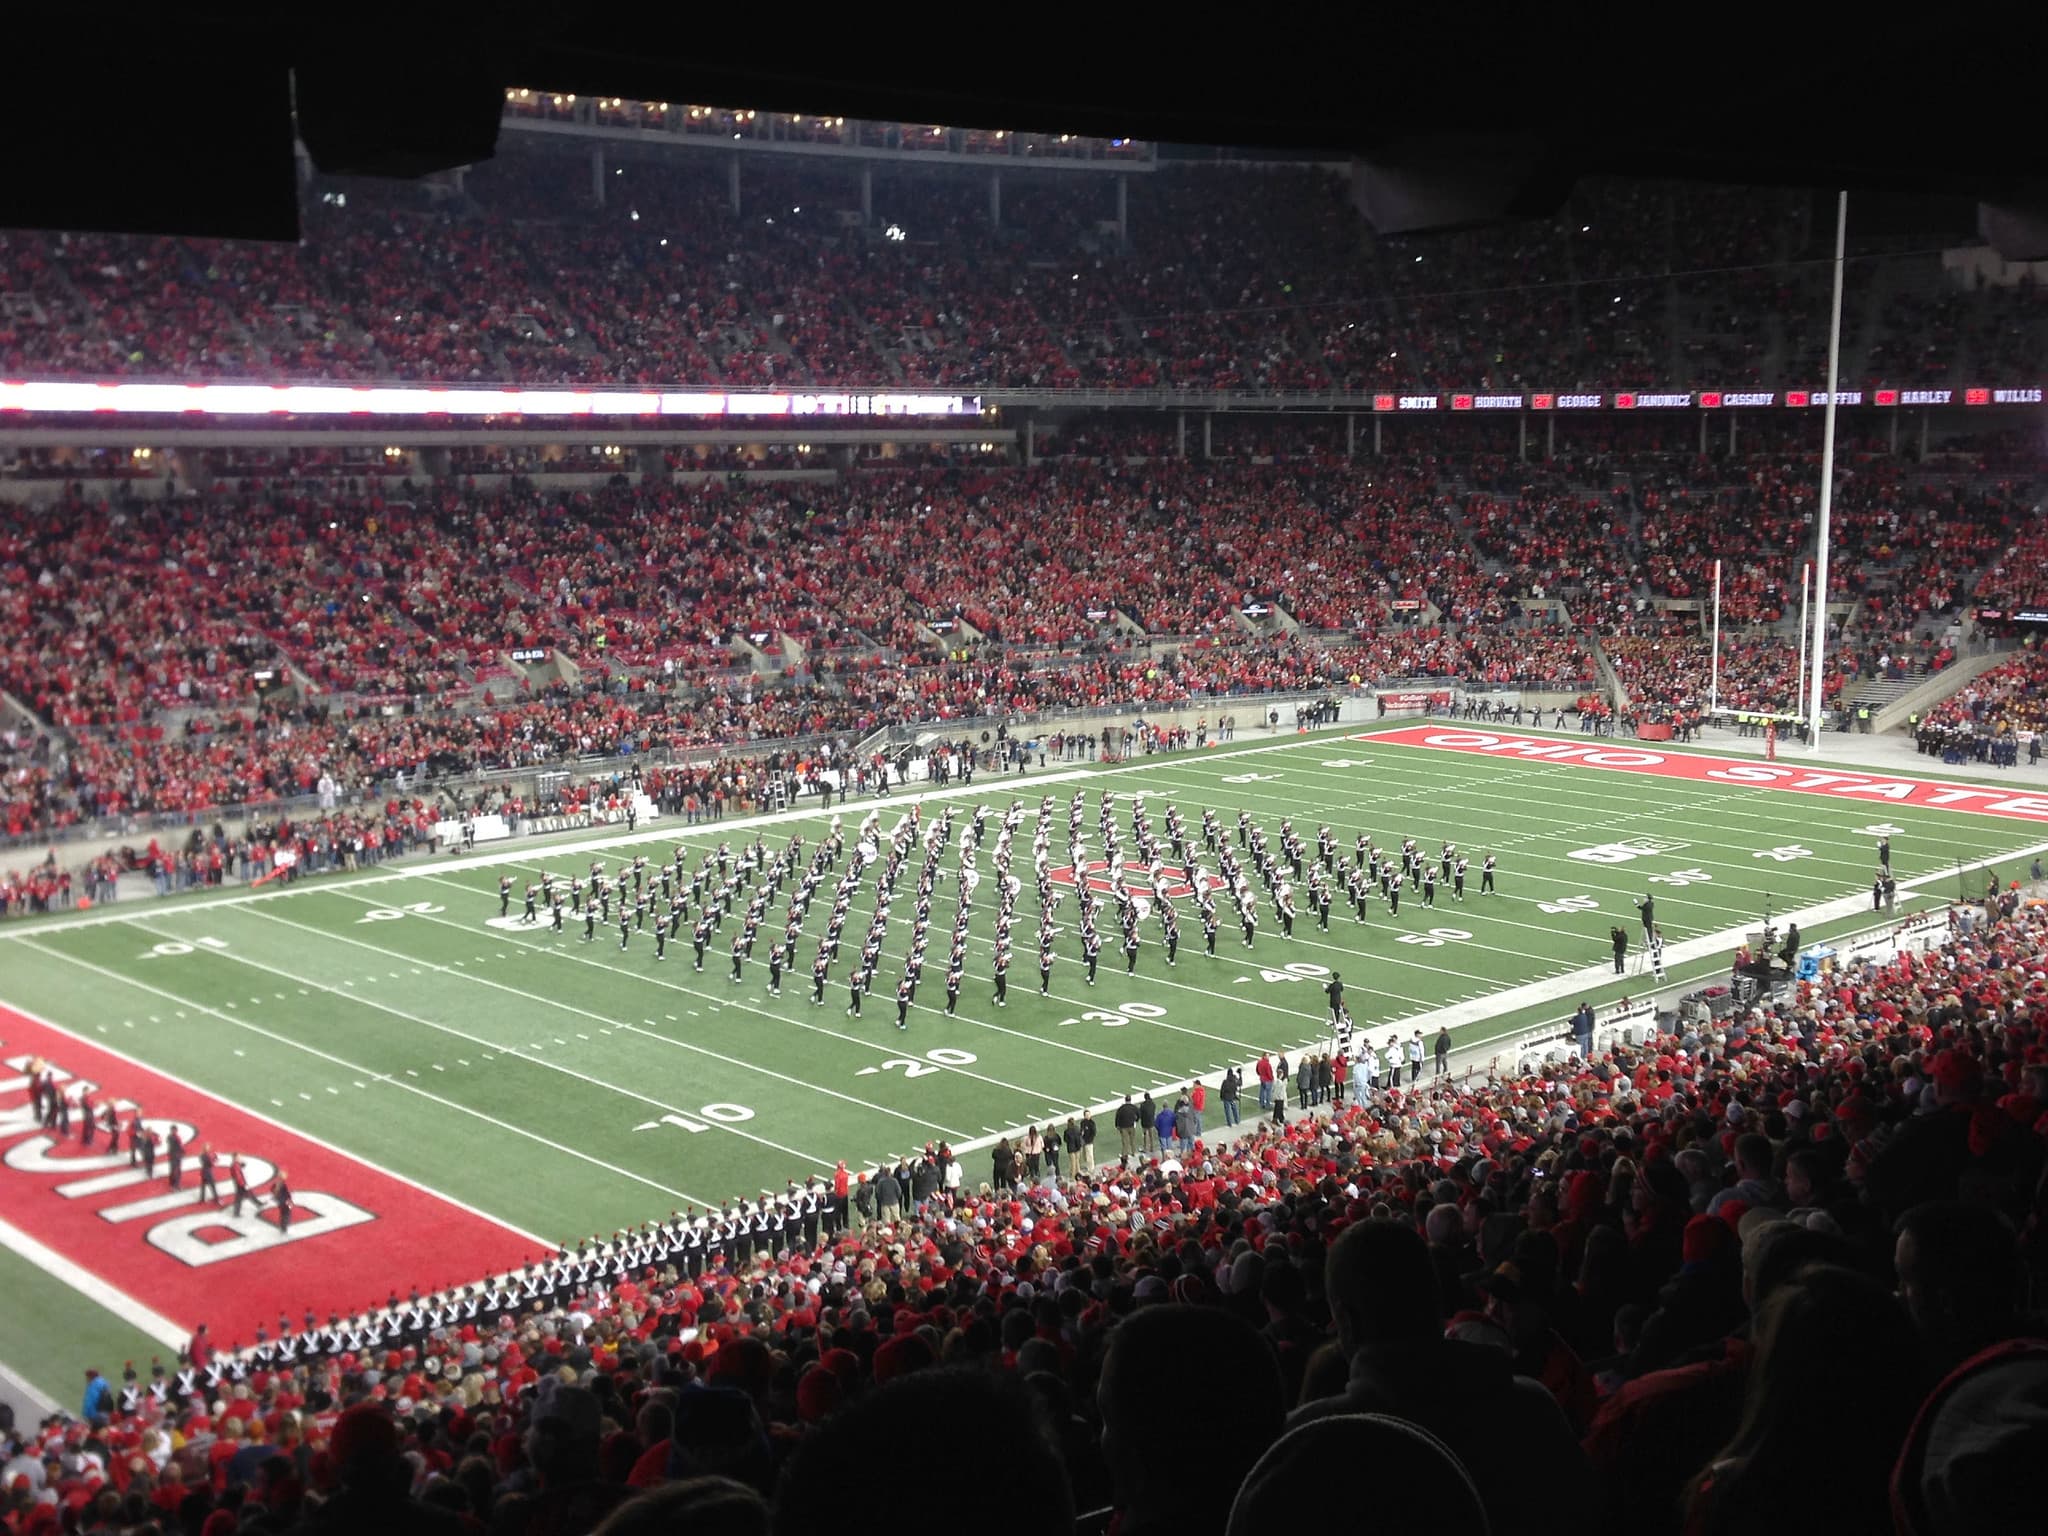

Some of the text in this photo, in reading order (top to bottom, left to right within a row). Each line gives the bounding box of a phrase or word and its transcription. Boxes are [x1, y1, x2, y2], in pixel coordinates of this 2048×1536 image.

[1399, 396, 1438, 409] SMITH
[1474, 396, 1522, 408] HORVATH
[1557, 395, 1601, 408] GEORGE
[1723, 393, 1775, 406] CASSADY
[1810, 392, 1862, 405] GRFFIN
[1900, 391, 1952, 404] HARLEY
[1993, 389, 2042, 403] WILLIS
[1424, 734, 2048, 816] OHIO STATE
[1752, 846, 1813, 862] 20
[1648, 870, 1713, 886] 30
[1536, 897, 1600, 914] 40
[1394, 928, 1474, 948] 50
[1259, 963, 1330, 983] 40
[1081, 1002, 1168, 1027] 30
[881, 1048, 977, 1079] 20
[659, 1103, 756, 1134] 10
